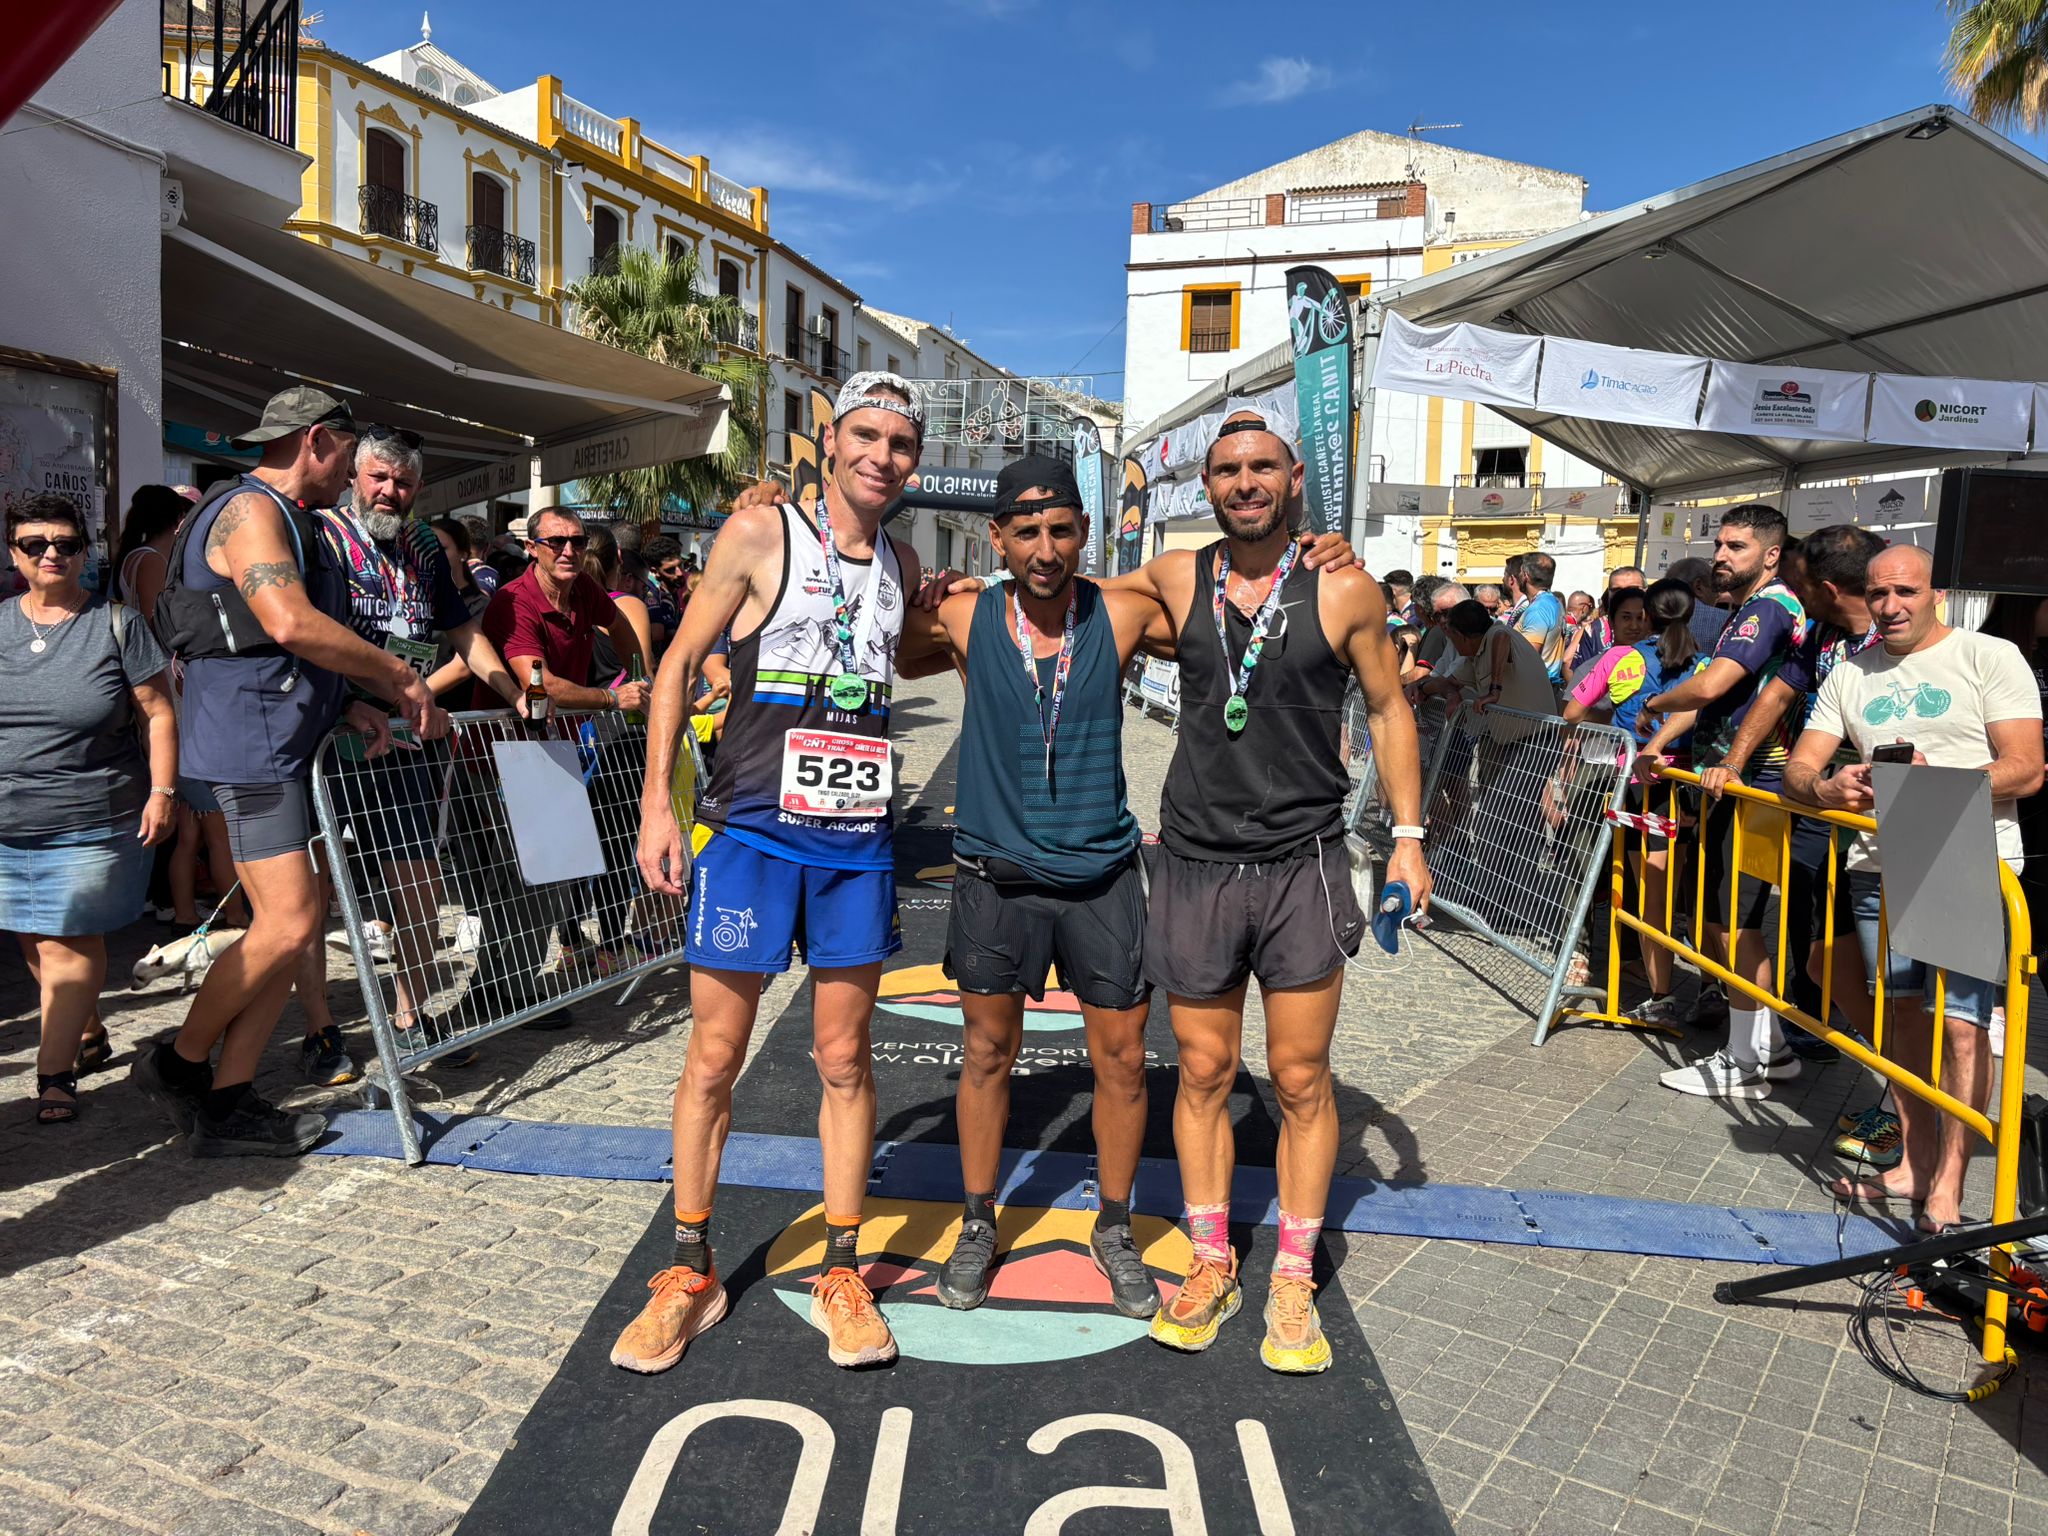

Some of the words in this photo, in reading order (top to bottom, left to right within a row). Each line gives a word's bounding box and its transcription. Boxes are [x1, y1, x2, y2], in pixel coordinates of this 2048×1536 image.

[1426, 359, 1443, 373] La
[1449, 360, 1493, 382] Piedra
[1602, 376, 1630, 391] Timac
[1939, 415, 1979, 424] Jardines
[1940, 404, 1988, 416] NICORT
[1314, 418, 1322, 431] LA
[1315, 433, 1329, 473] CAÑETE
[45, 472, 88, 492] CAÑOS
[1319, 474, 1333, 522] CICLISTA
[826, 711, 858, 725] MIJAS
[796, 755, 881, 791] 523
[778, 813, 822, 829] SUPER
[826, 822, 877, 833] ARCADE
